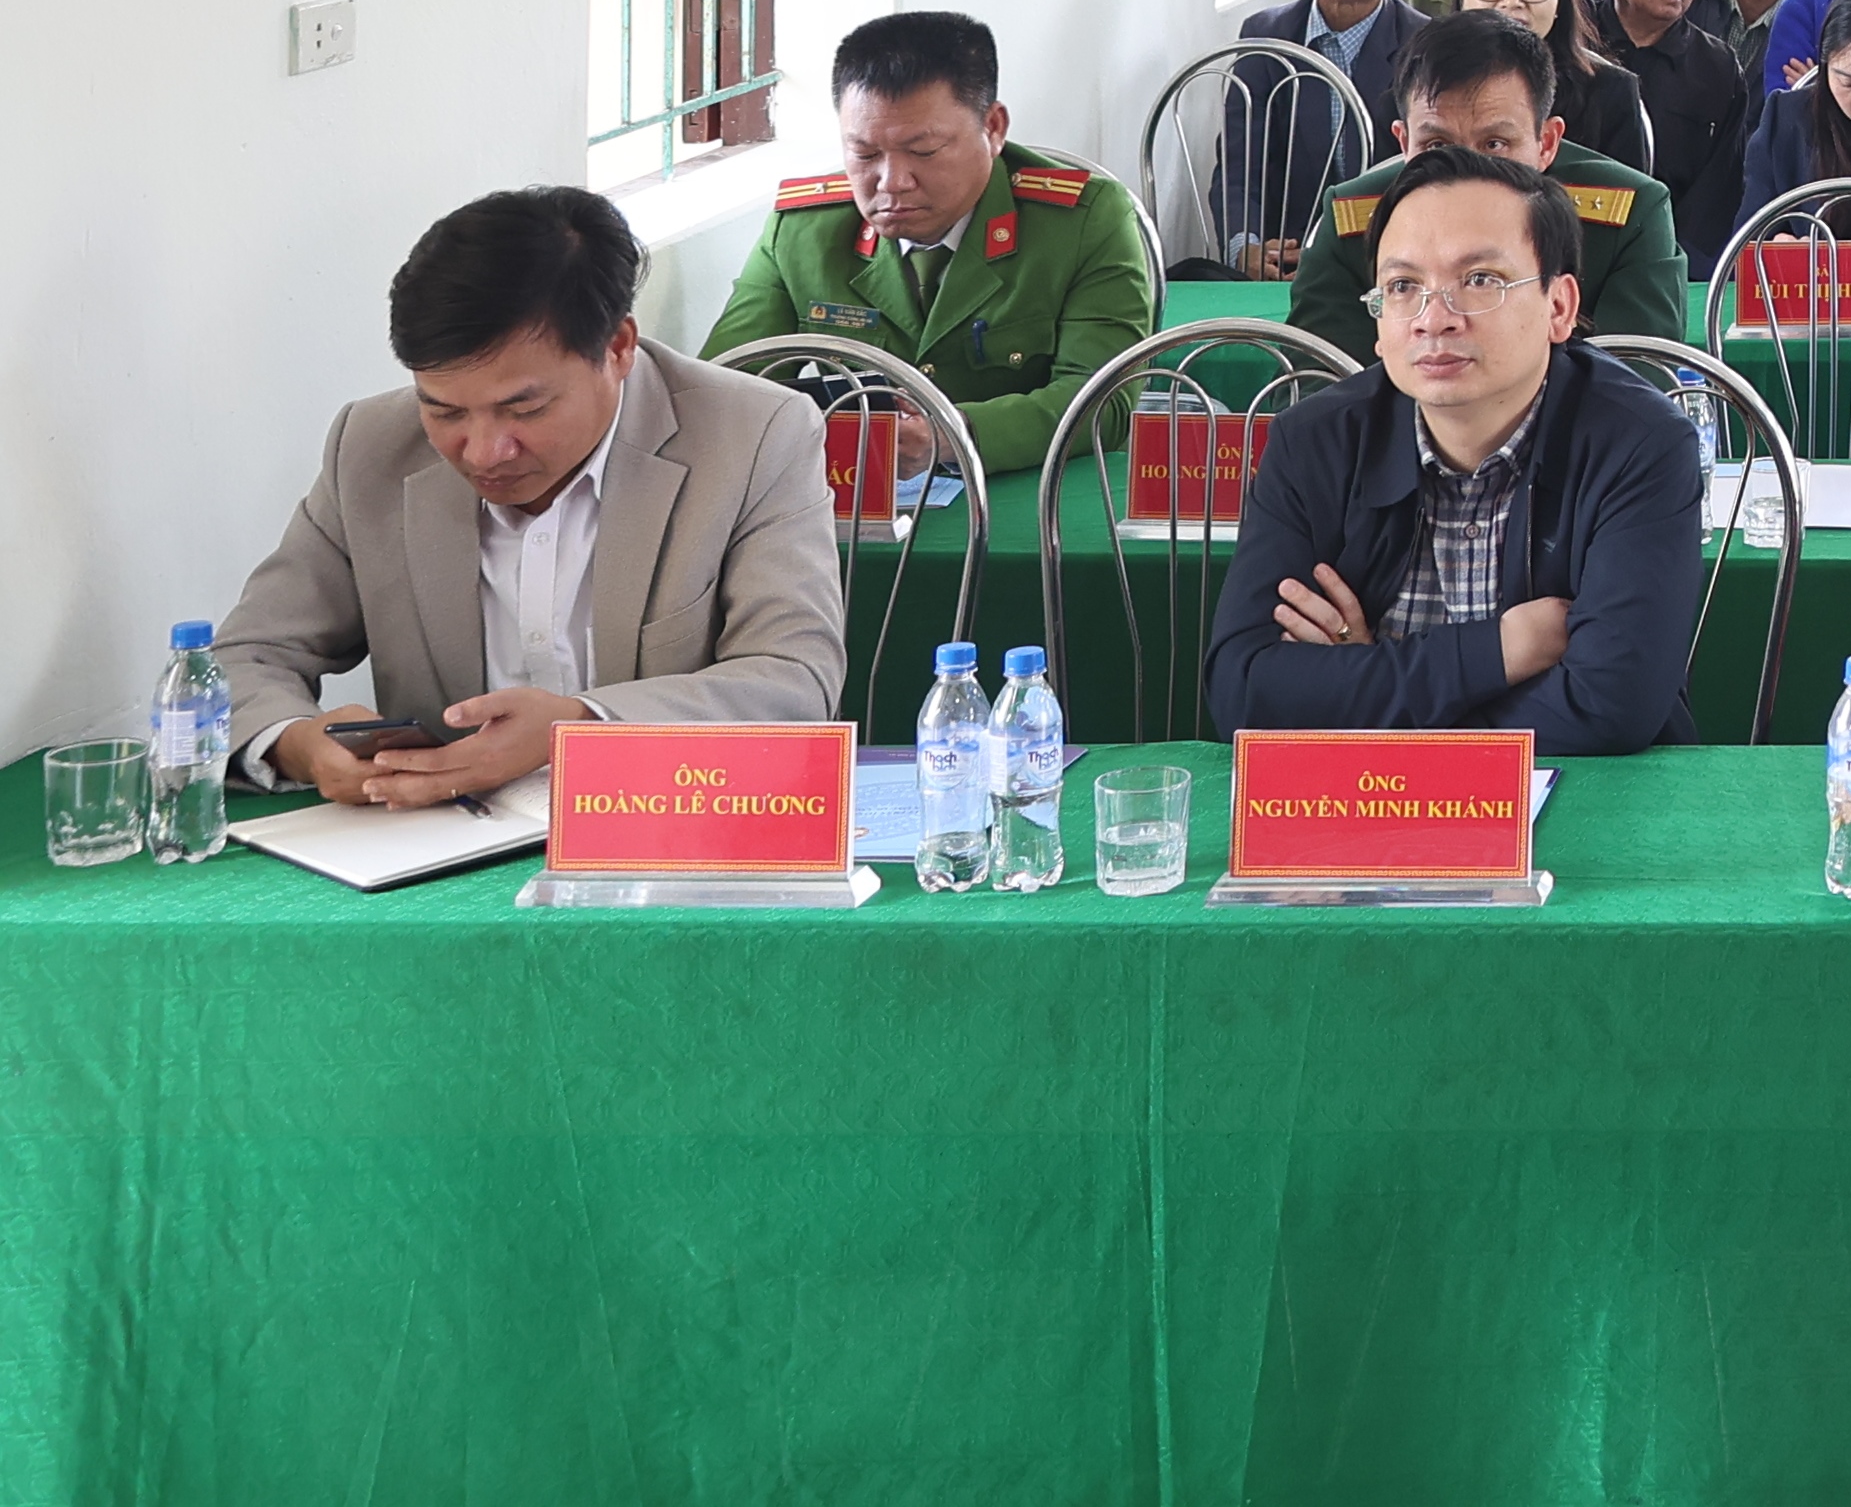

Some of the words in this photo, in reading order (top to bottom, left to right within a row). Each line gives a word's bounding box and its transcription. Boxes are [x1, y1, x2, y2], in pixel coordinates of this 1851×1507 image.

[1140, 463, 1206, 480] HONG
[673, 763, 727, 787] ÔNG
[1357, 770, 1407, 793] ÔNG
[573, 789, 667, 815] HOÀNG
[673, 790, 706, 815] LÊ
[712, 792, 827, 816] CHƯƠNG
[1248, 795, 1350, 820] NGUYỄN
[1354, 799, 1421, 820] MINH
[1426, 796, 1514, 820] KHÁNH
